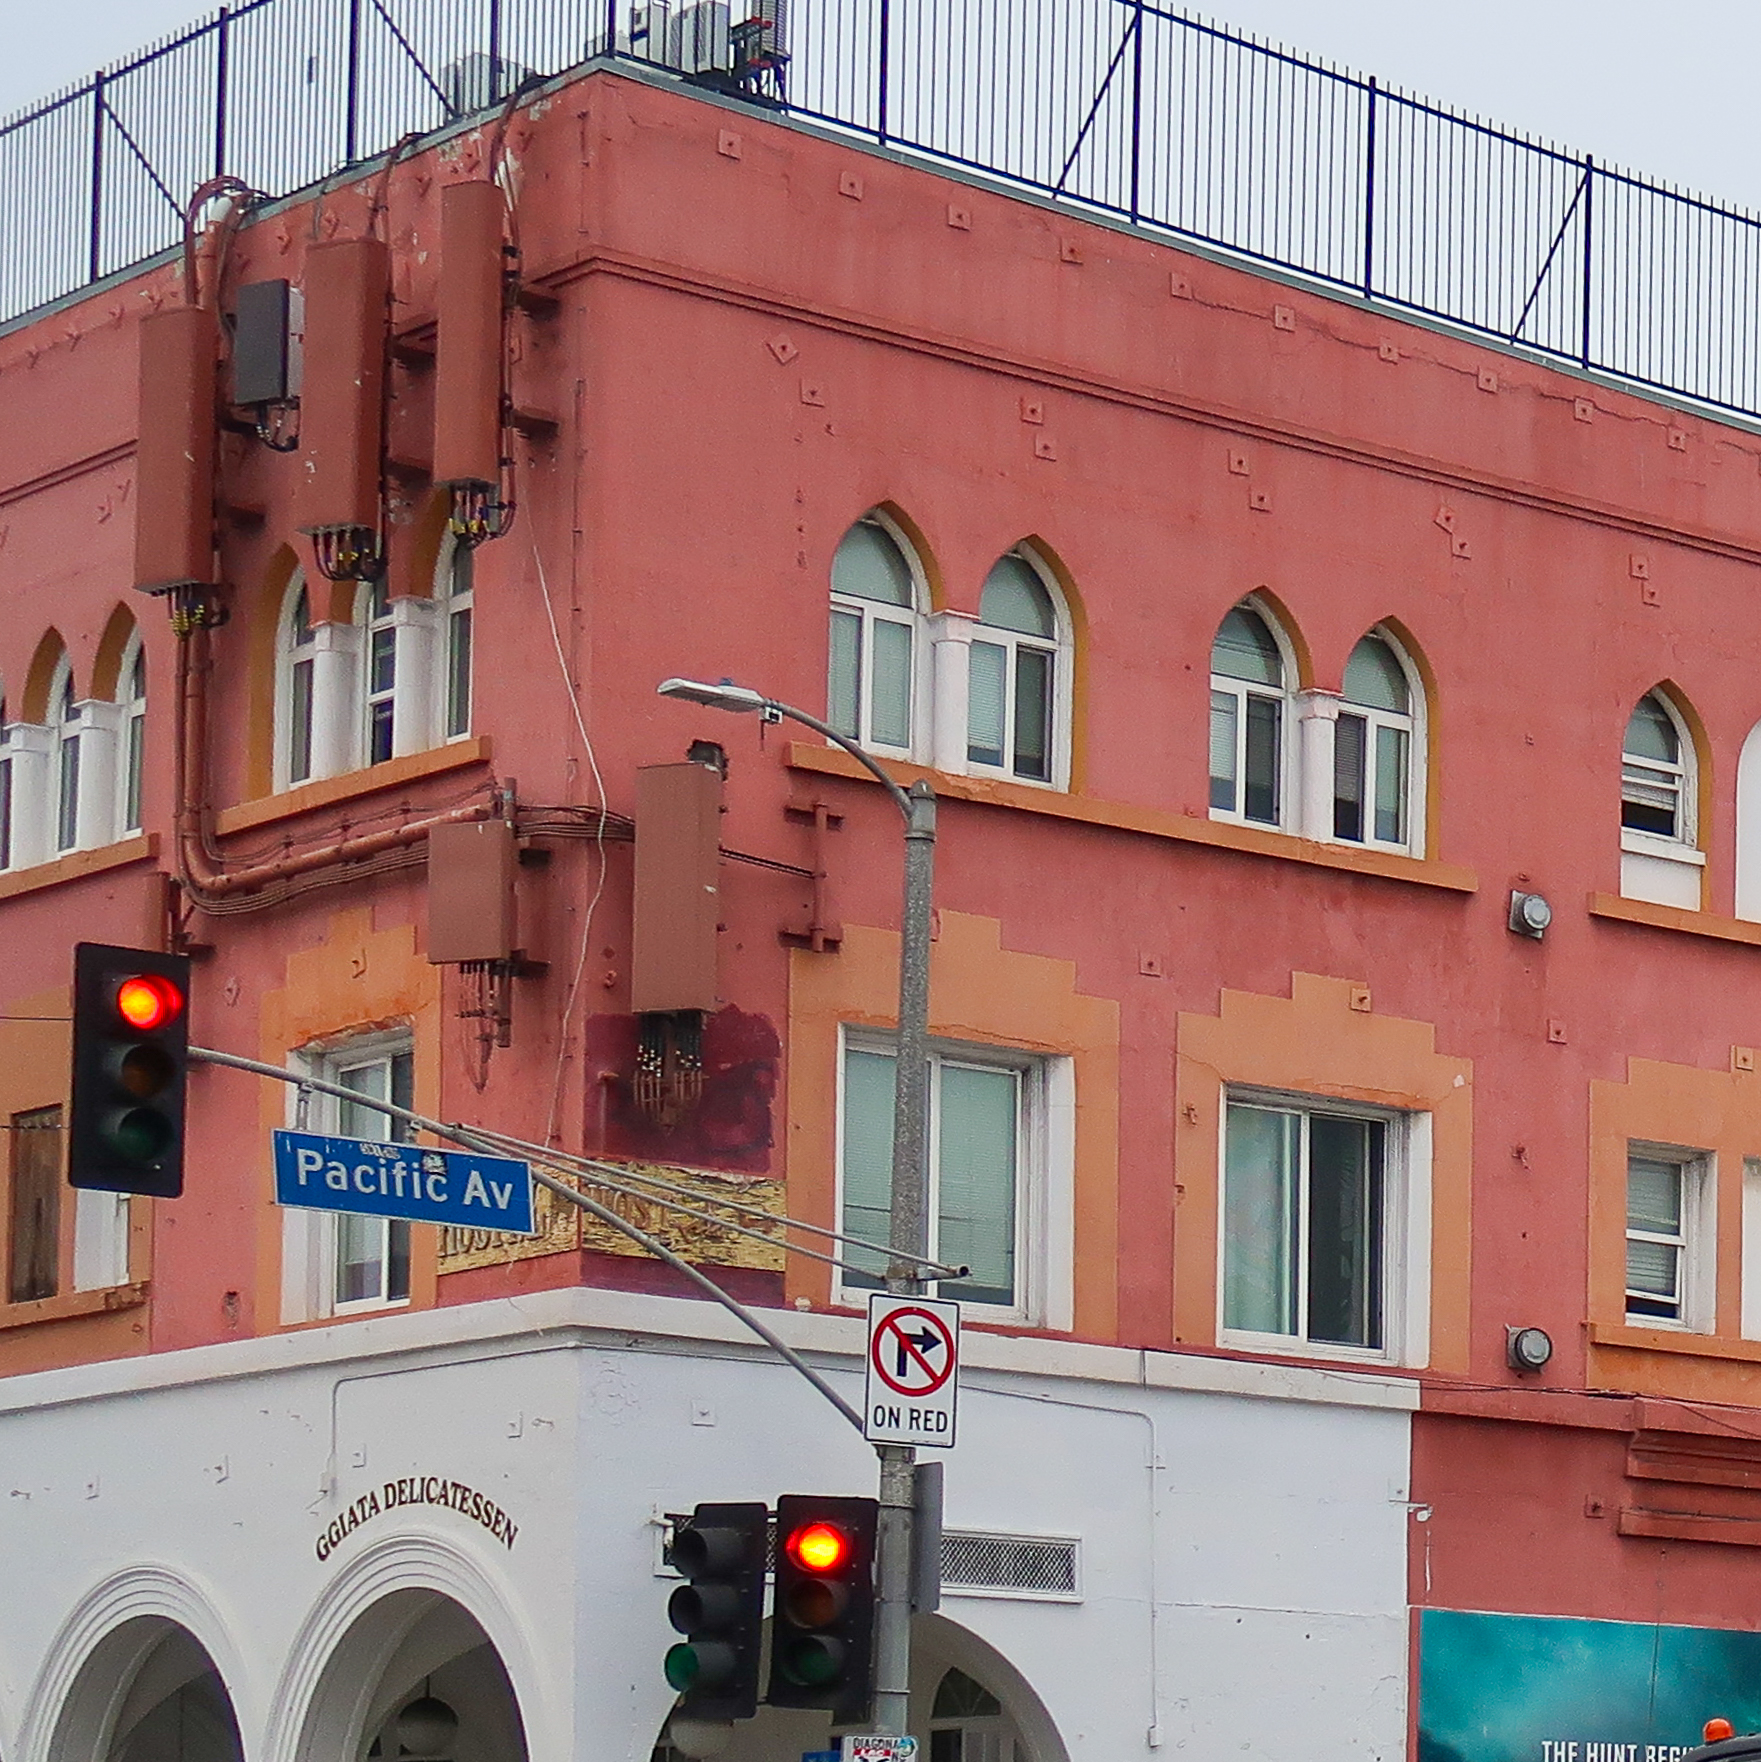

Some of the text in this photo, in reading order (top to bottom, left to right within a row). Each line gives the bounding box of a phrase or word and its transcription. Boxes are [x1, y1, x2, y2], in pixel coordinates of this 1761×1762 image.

[296, 1148, 449, 1203] Pacific
[462, 1170, 514, 1210] Av
[873, 1404, 948, 1433] ON RED
[316, 1476, 520, 1562] GGIATA DELICATESSEN
